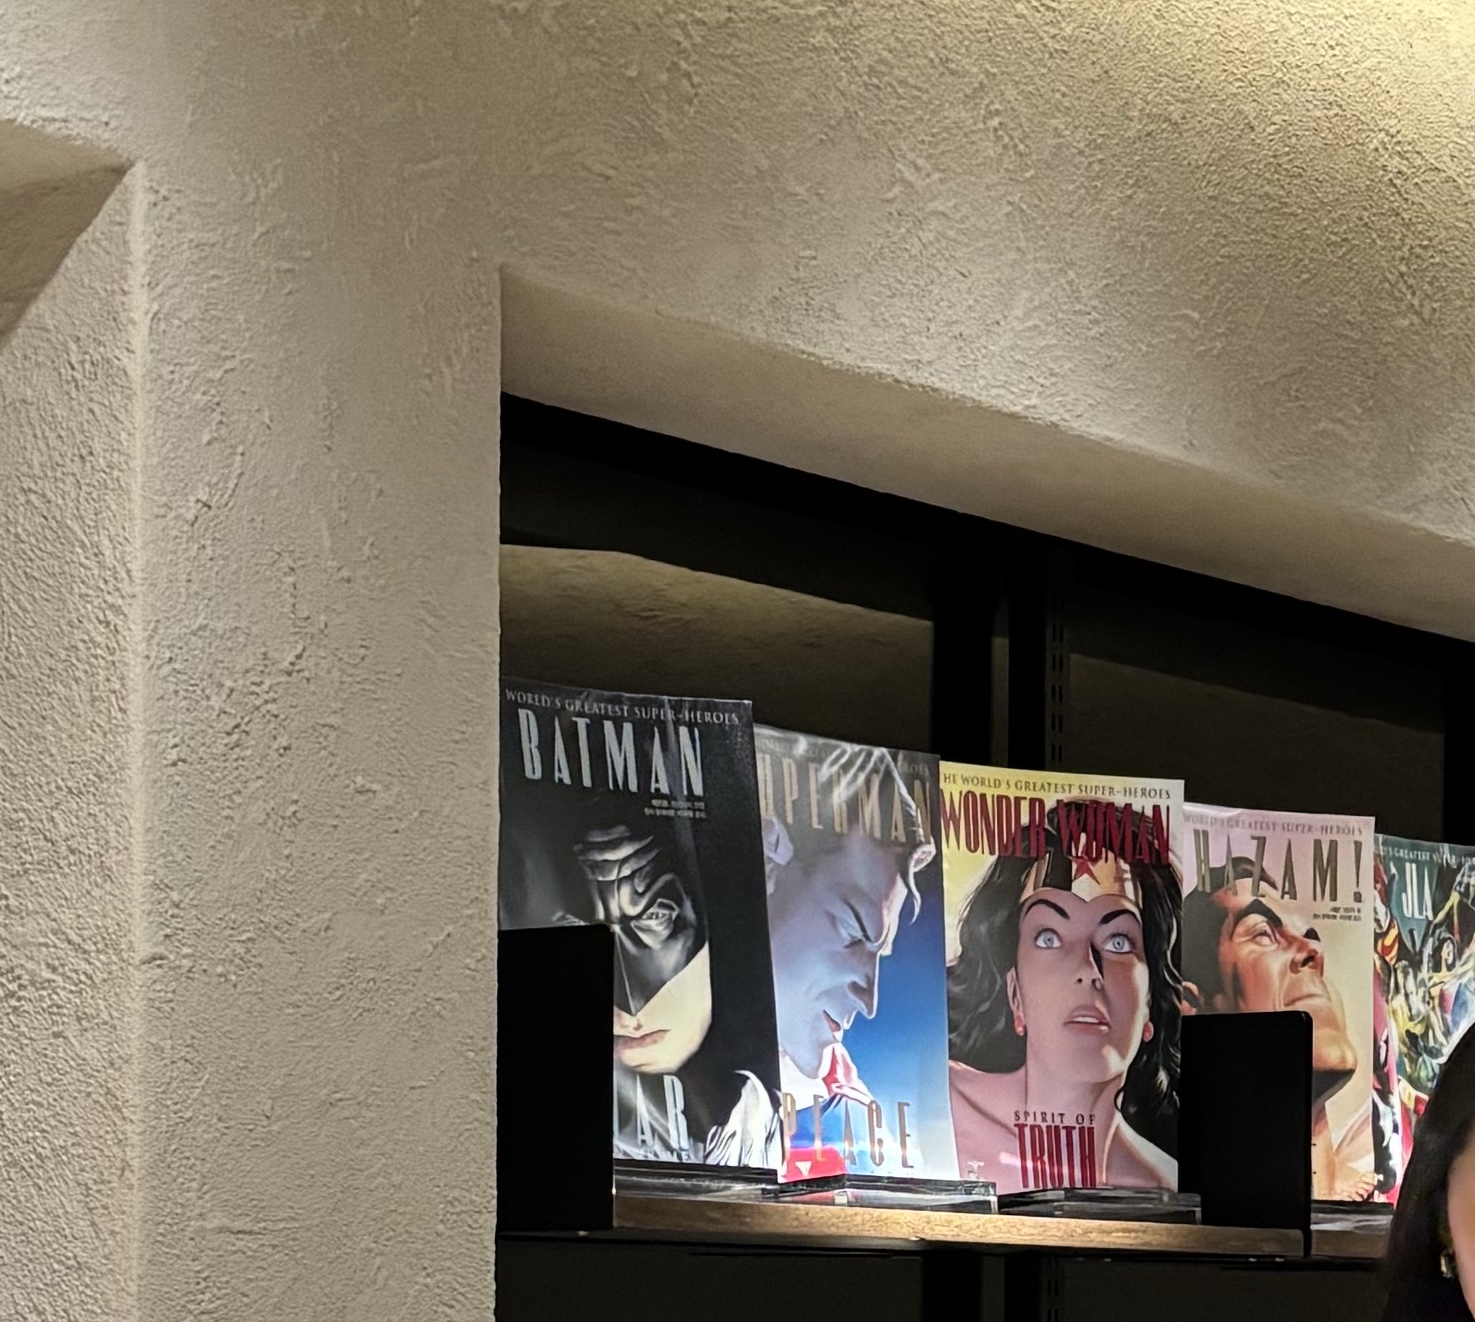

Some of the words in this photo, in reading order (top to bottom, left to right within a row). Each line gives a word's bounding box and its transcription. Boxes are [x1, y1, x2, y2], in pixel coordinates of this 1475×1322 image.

[565, 698, 629, 718] GREATEST
[634, 706, 740, 725] SUPER-HEROES
[518, 708, 704, 797] BATMAN
[943, 772, 959, 784] HE
[961, 774, 1011, 790] WORLD'S
[1014, 779, 1074, 795] GREATEST
[1078, 784, 1171, 799] SUPER-HEROES
[757, 753, 932, 844] UPERMAN
[940, 788, 1047, 858] WONDER
[1056, 799, 1171, 865] WOMAN
[1193, 828, 1363, 903] HAZAM!
[1401, 861, 1434, 921] JLA
[782, 1092, 914, 1169] PEACE
[1014, 1110, 1066, 1124] SPIRIT
[1076, 1113, 1095, 1126] OF
[1014, 1123, 1097, 1189] TRUTH
